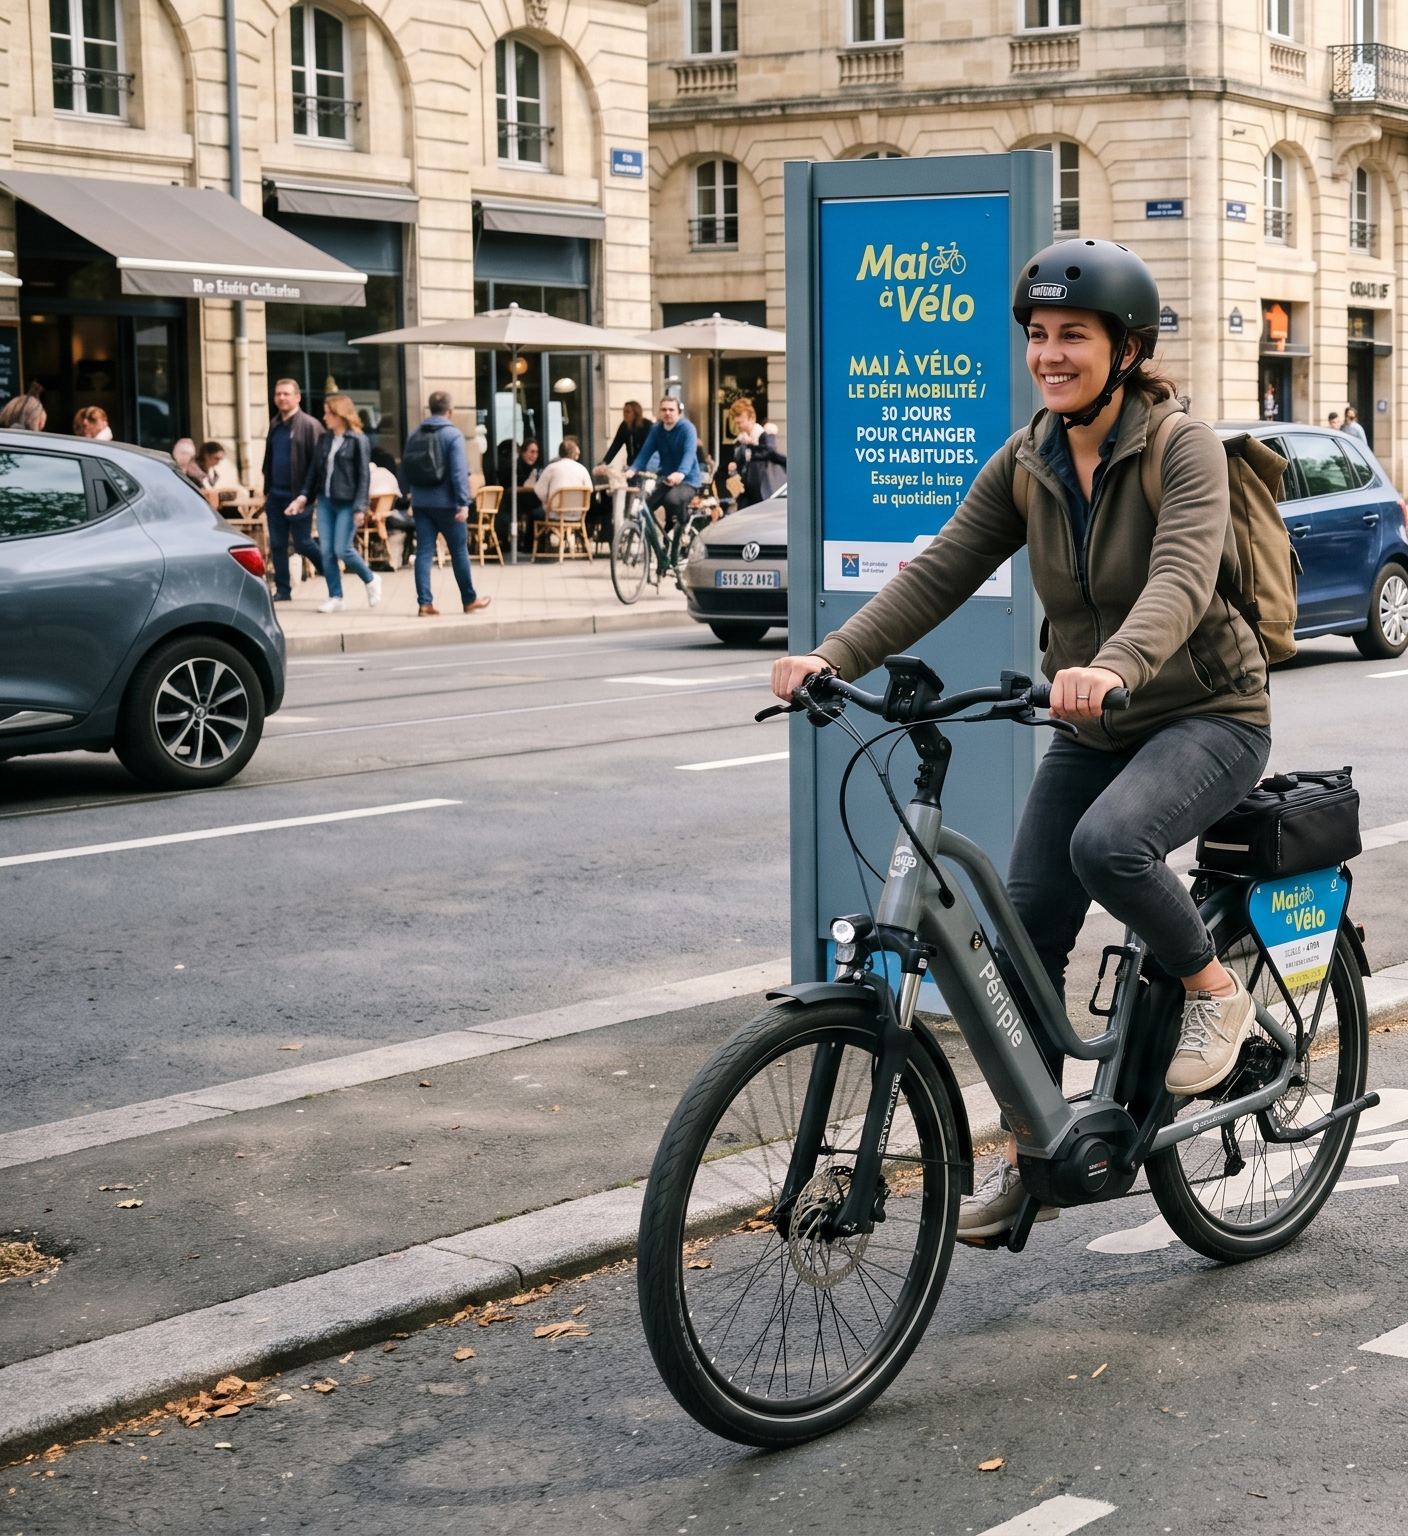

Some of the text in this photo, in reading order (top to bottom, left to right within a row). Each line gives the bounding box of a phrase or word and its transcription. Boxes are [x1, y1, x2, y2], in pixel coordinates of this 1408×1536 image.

[856, 242, 929, 281] Mai
[879, 284, 975, 322] à Vélo
[849, 355, 889, 376] MAI
[894, 349, 910, 376] À
[914, 349, 971, 376] VÉLO
[848, 383, 865, 398] LE
[868, 380, 902, 398] DÉFI
[906, 379, 977, 399] MOBILITÉ
[881, 406, 951, 421] 30 JOURS
[857, 427, 976, 443] POUR CHANGER
[855, 448, 979, 464] VOS HABITUDES.
[871, 470, 918, 490] Essayez
[922, 471, 933, 485] le
[872, 494, 887, 505] au
[891, 491, 951, 508] quotidien
[1271, 886, 1299, 913] Mai
[1293, 906, 1325, 932] Vélo
[979, 960, 1023, 1047] Périple
